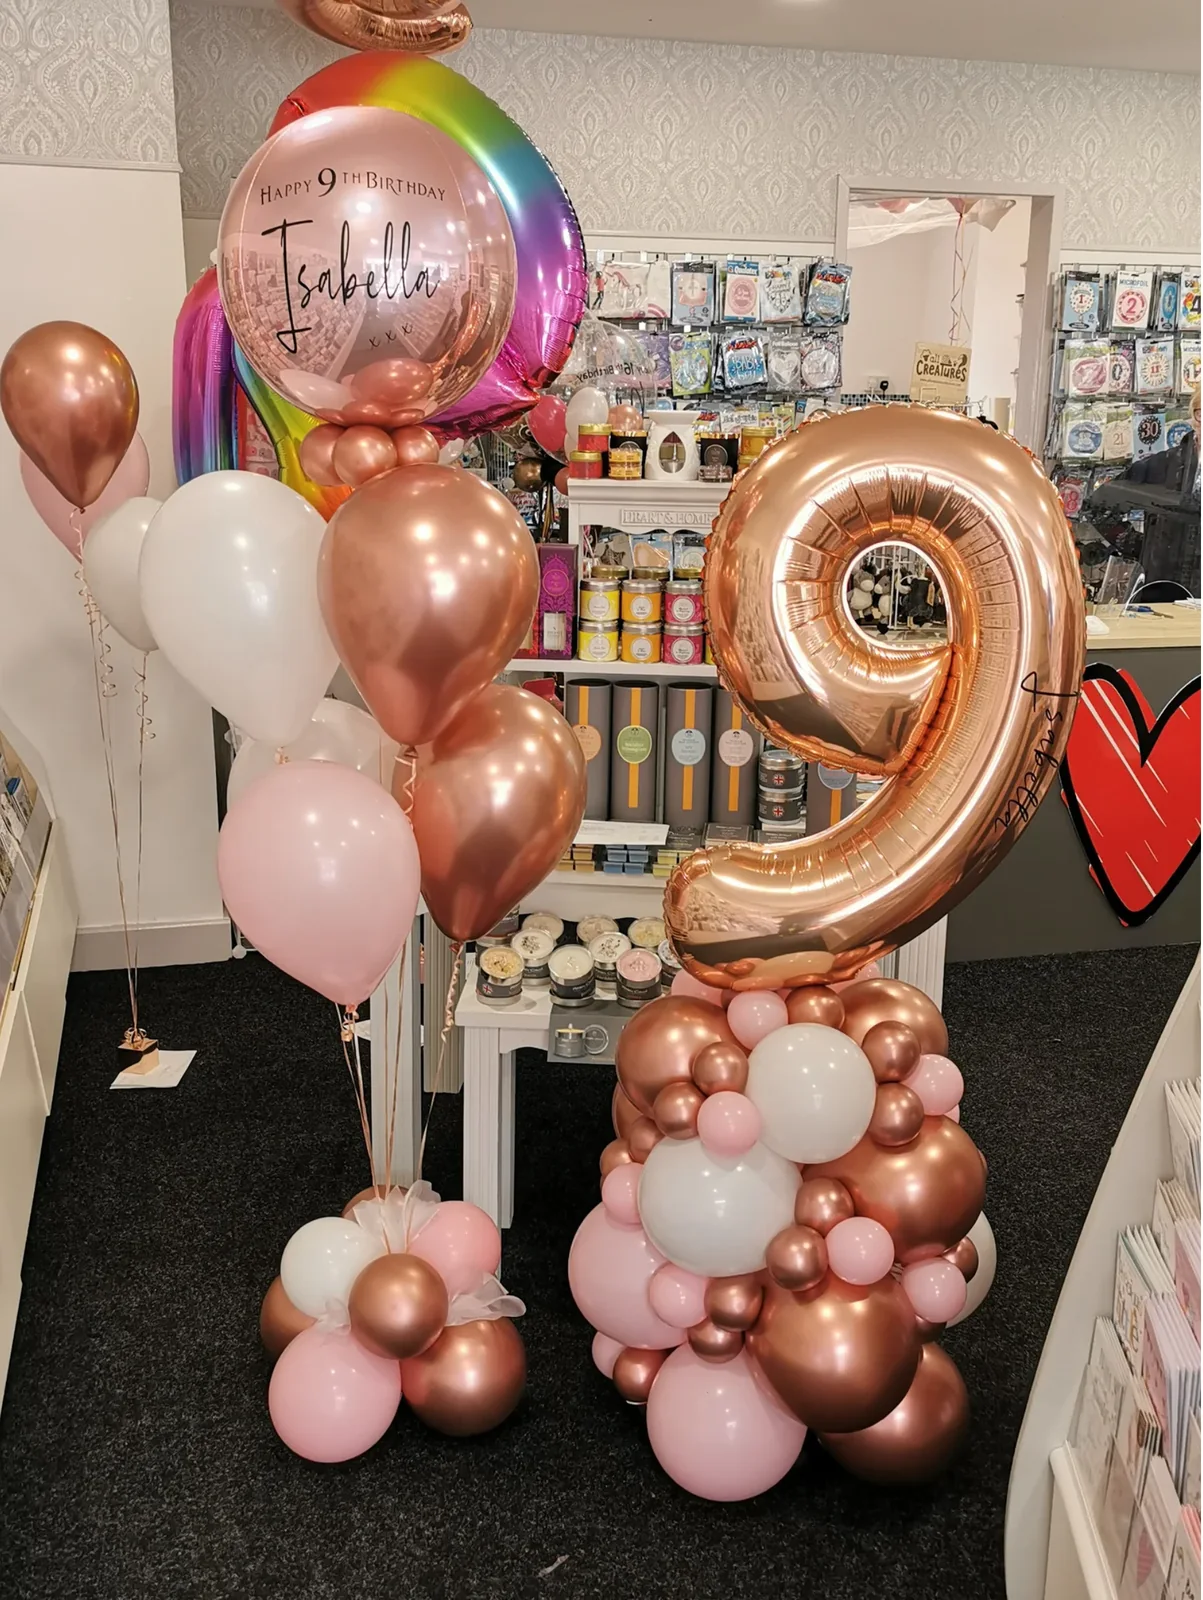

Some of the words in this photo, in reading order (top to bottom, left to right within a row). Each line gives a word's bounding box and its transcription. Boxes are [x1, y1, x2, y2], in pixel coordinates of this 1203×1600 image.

[260, 179, 312, 205] HAPPY
[366, 171, 446, 201] BIRTHDAY
[261, 218, 441, 354] Isabella
[1126, 297, 1137, 314] 2
[1141, 421, 1160, 438] 30
[1113, 432, 1125, 446] 21
[624, 510, 663, 524] HEART
[994, 671, 1082, 833] Isabella
